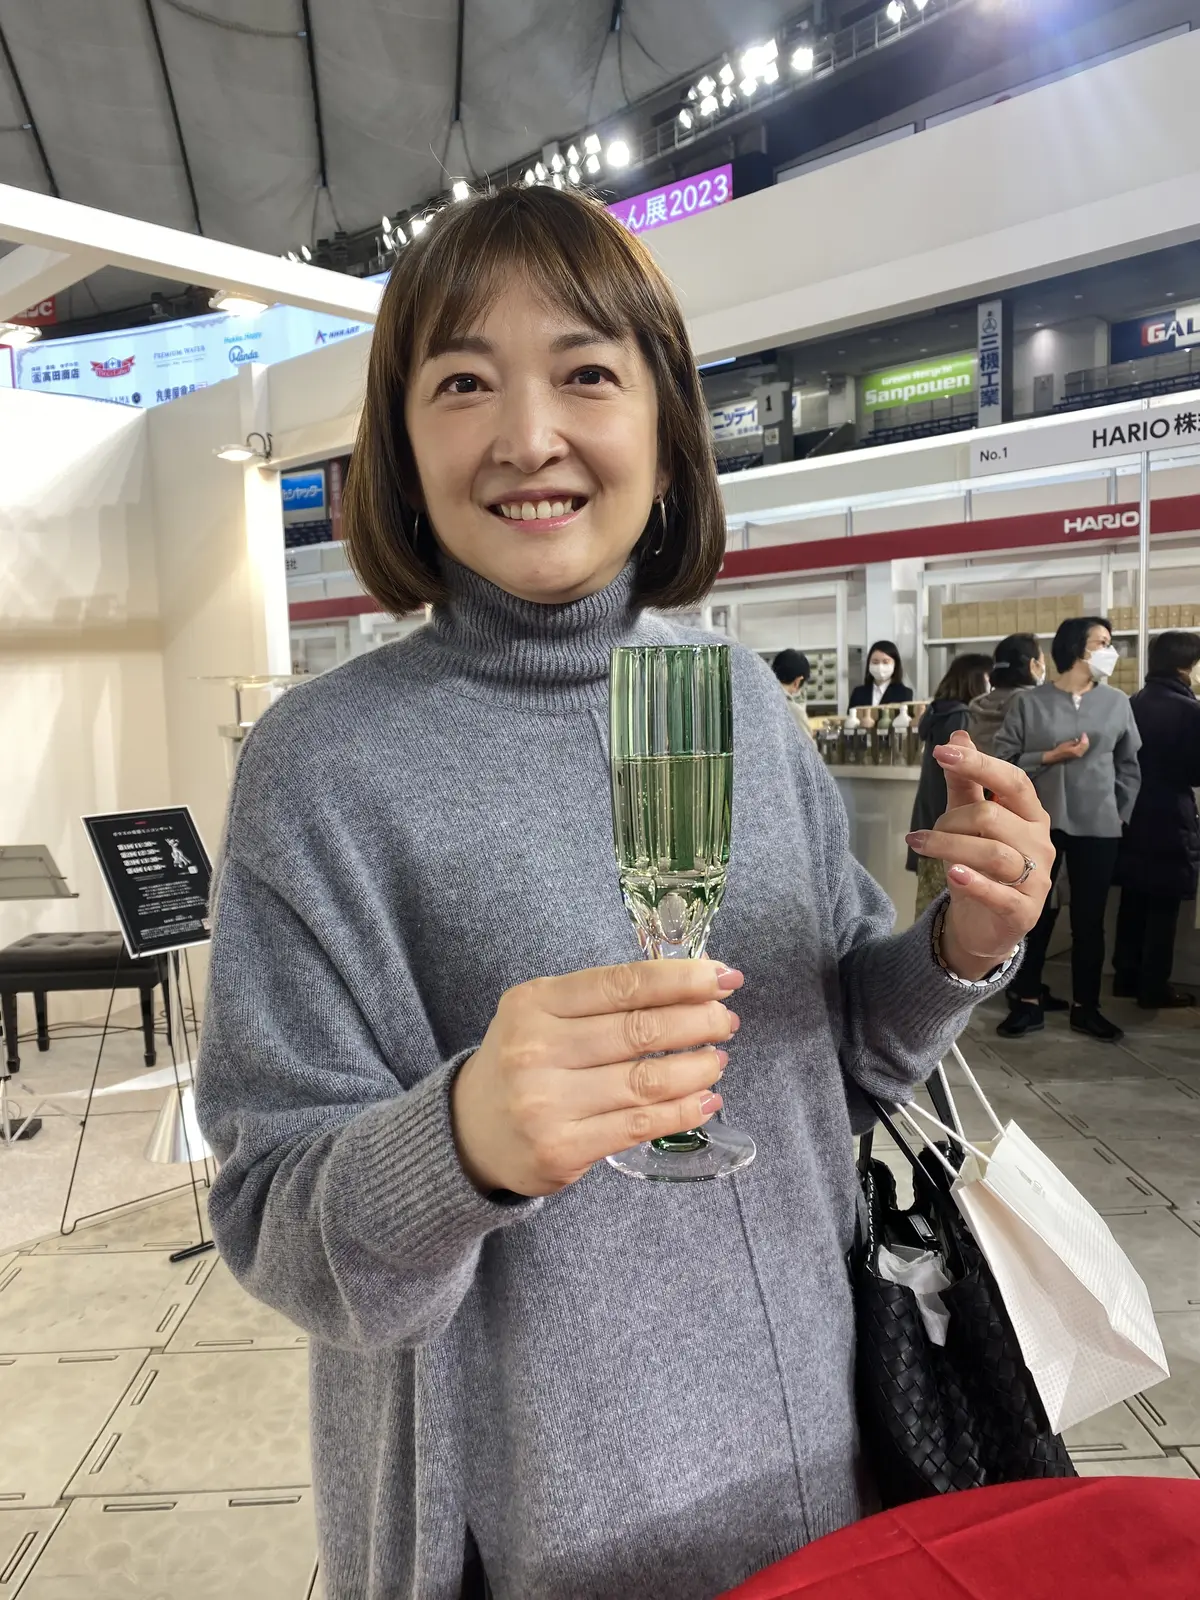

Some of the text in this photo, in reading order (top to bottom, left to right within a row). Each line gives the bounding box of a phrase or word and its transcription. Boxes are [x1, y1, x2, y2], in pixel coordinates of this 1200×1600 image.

[980, 333, 1000, 408] 三機工業
[766, 395, 772, 411] 1
[865, 374, 971, 406] Sanpouen
[1092, 411, 1200, 448] HARIO 株
[979, 447, 1008, 462] No.1
[1063, 510, 1141, 535] HARIO
